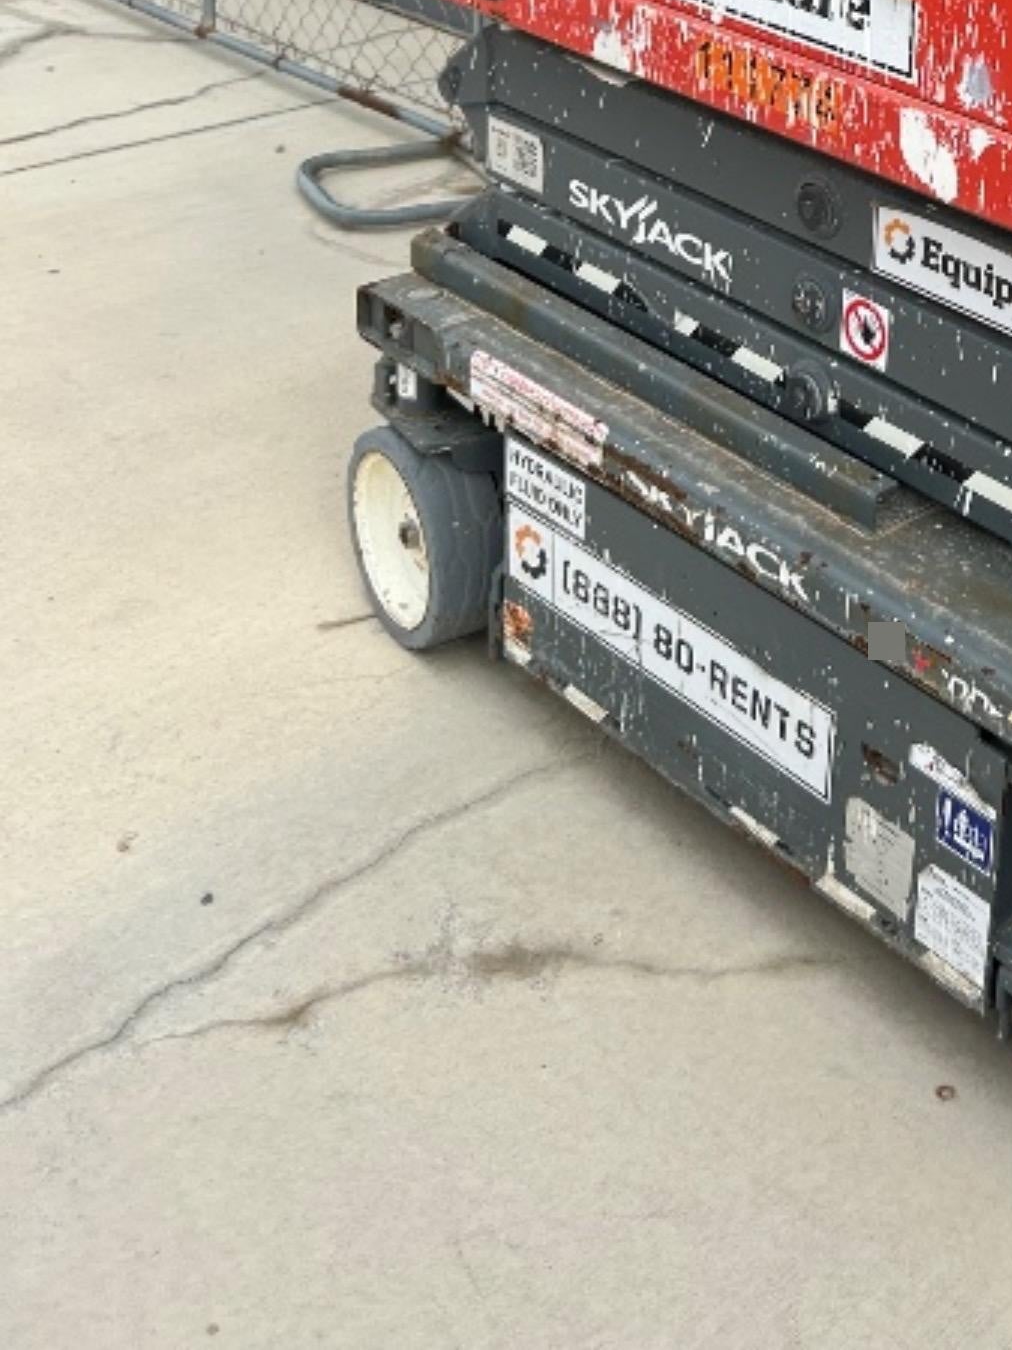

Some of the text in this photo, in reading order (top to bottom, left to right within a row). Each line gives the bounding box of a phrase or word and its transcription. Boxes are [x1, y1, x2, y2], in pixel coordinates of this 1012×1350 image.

[569, 179, 733, 281] SKYJACK
[562, 561, 644, 641] (888)
[652, 622, 816, 759] 80-RENTS
